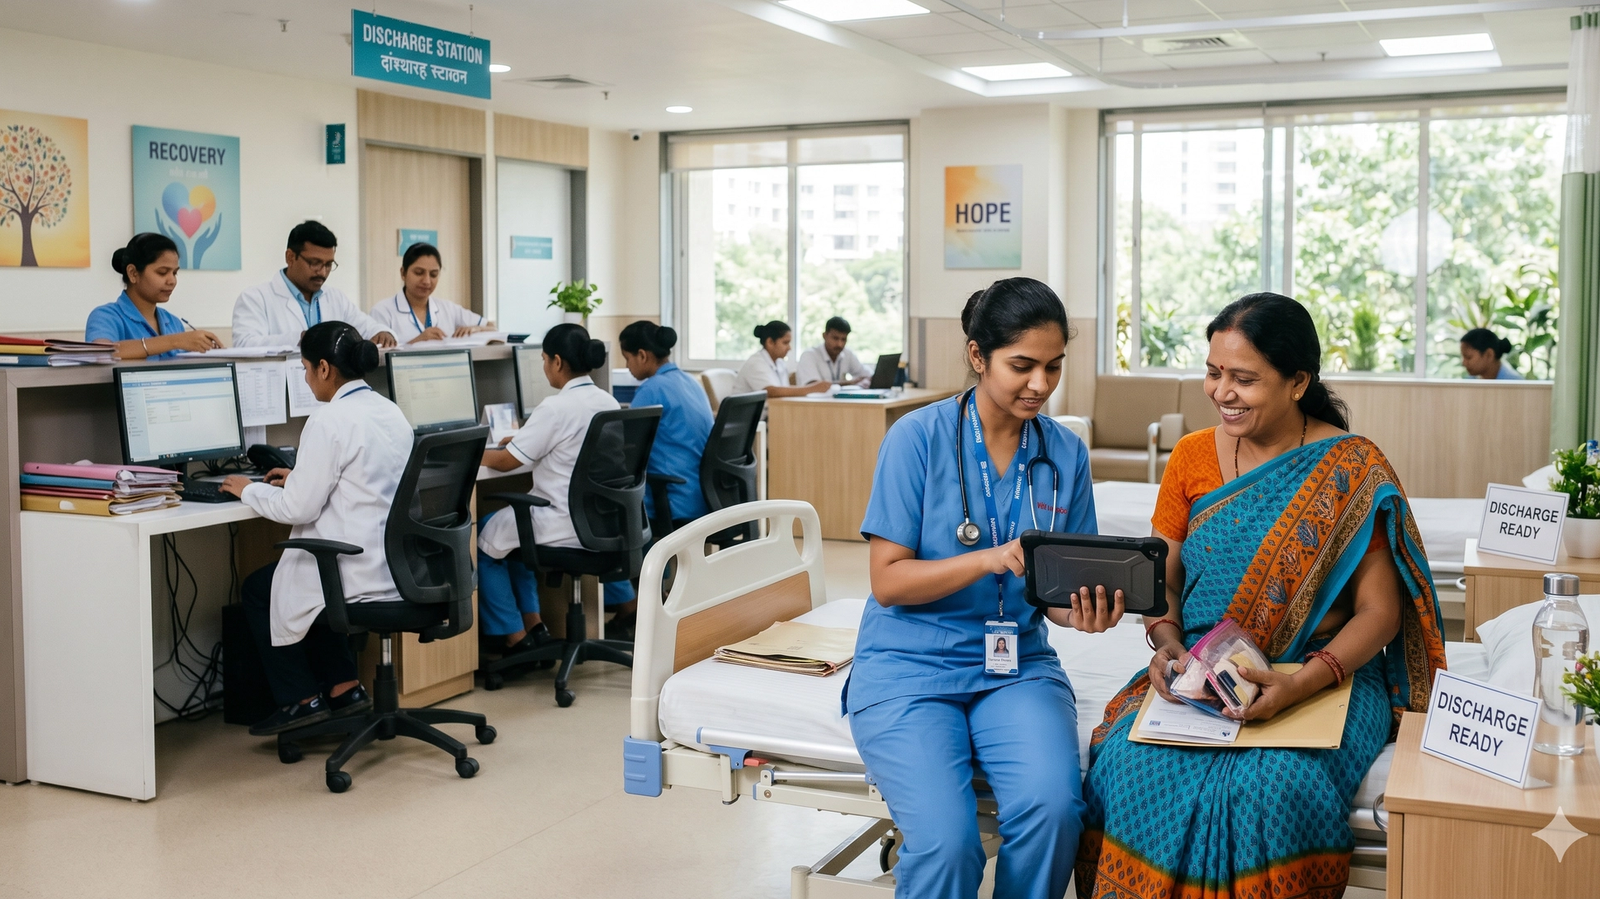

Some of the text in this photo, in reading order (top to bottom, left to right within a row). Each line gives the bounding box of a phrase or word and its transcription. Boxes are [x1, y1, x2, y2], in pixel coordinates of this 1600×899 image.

[363, 23, 483, 65] DISCHARGE STATION
[149, 141, 226, 165] RECOVERY
[955, 202, 1011, 224] HOPE
[1489, 501, 1559, 523] DISCHARGE
[1499, 521, 1541, 539] READY
[1437, 691, 1529, 736] DISCHARGE
[1449, 723, 1503, 756] READY
